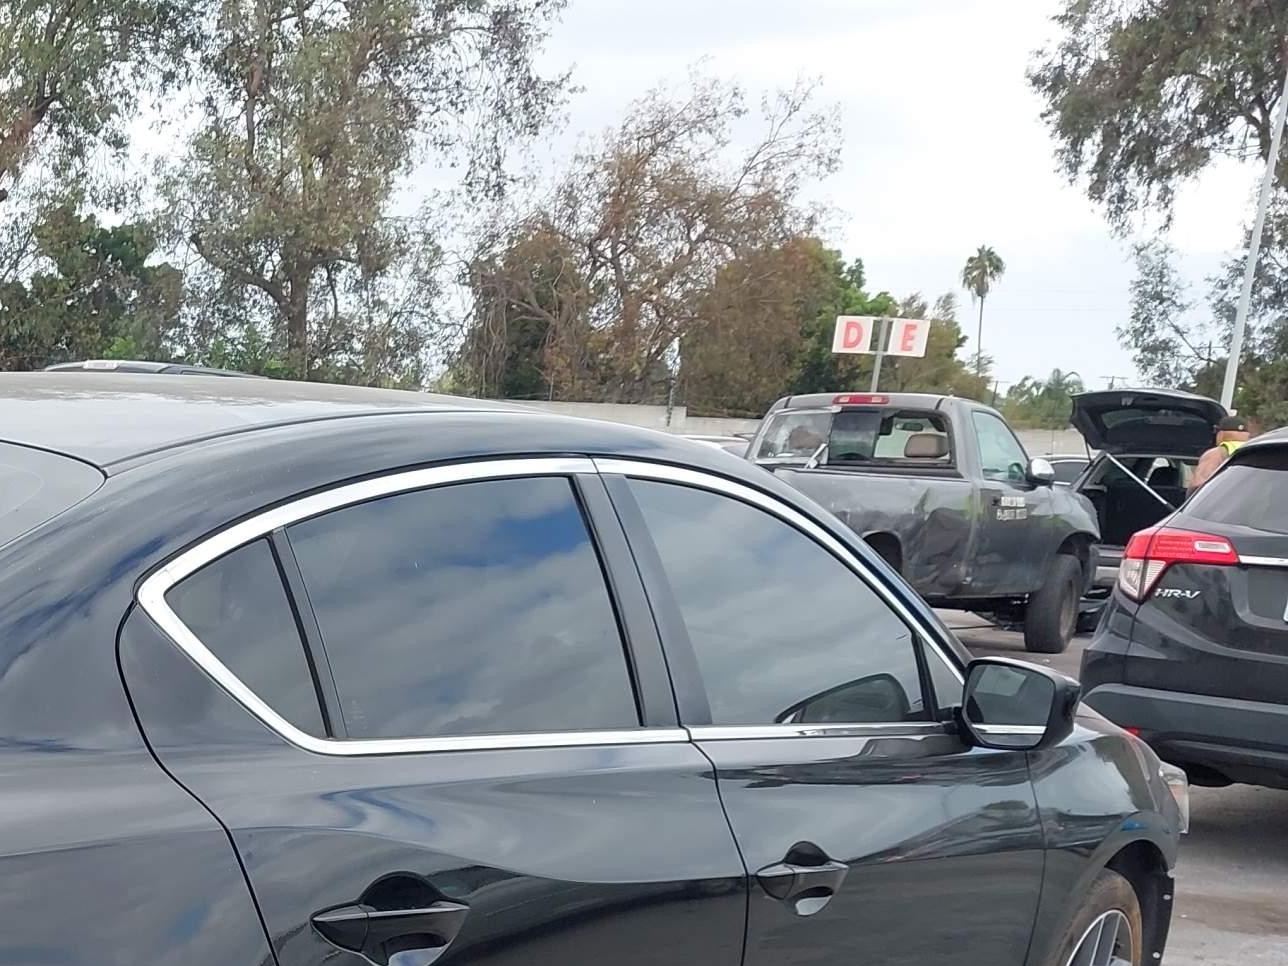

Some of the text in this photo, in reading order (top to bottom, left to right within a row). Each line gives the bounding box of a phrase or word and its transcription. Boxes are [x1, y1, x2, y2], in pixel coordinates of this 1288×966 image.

[843, 321, 864, 348] D
[901, 323, 918, 351] E
[1154, 588, 1201, 599] HR-V
